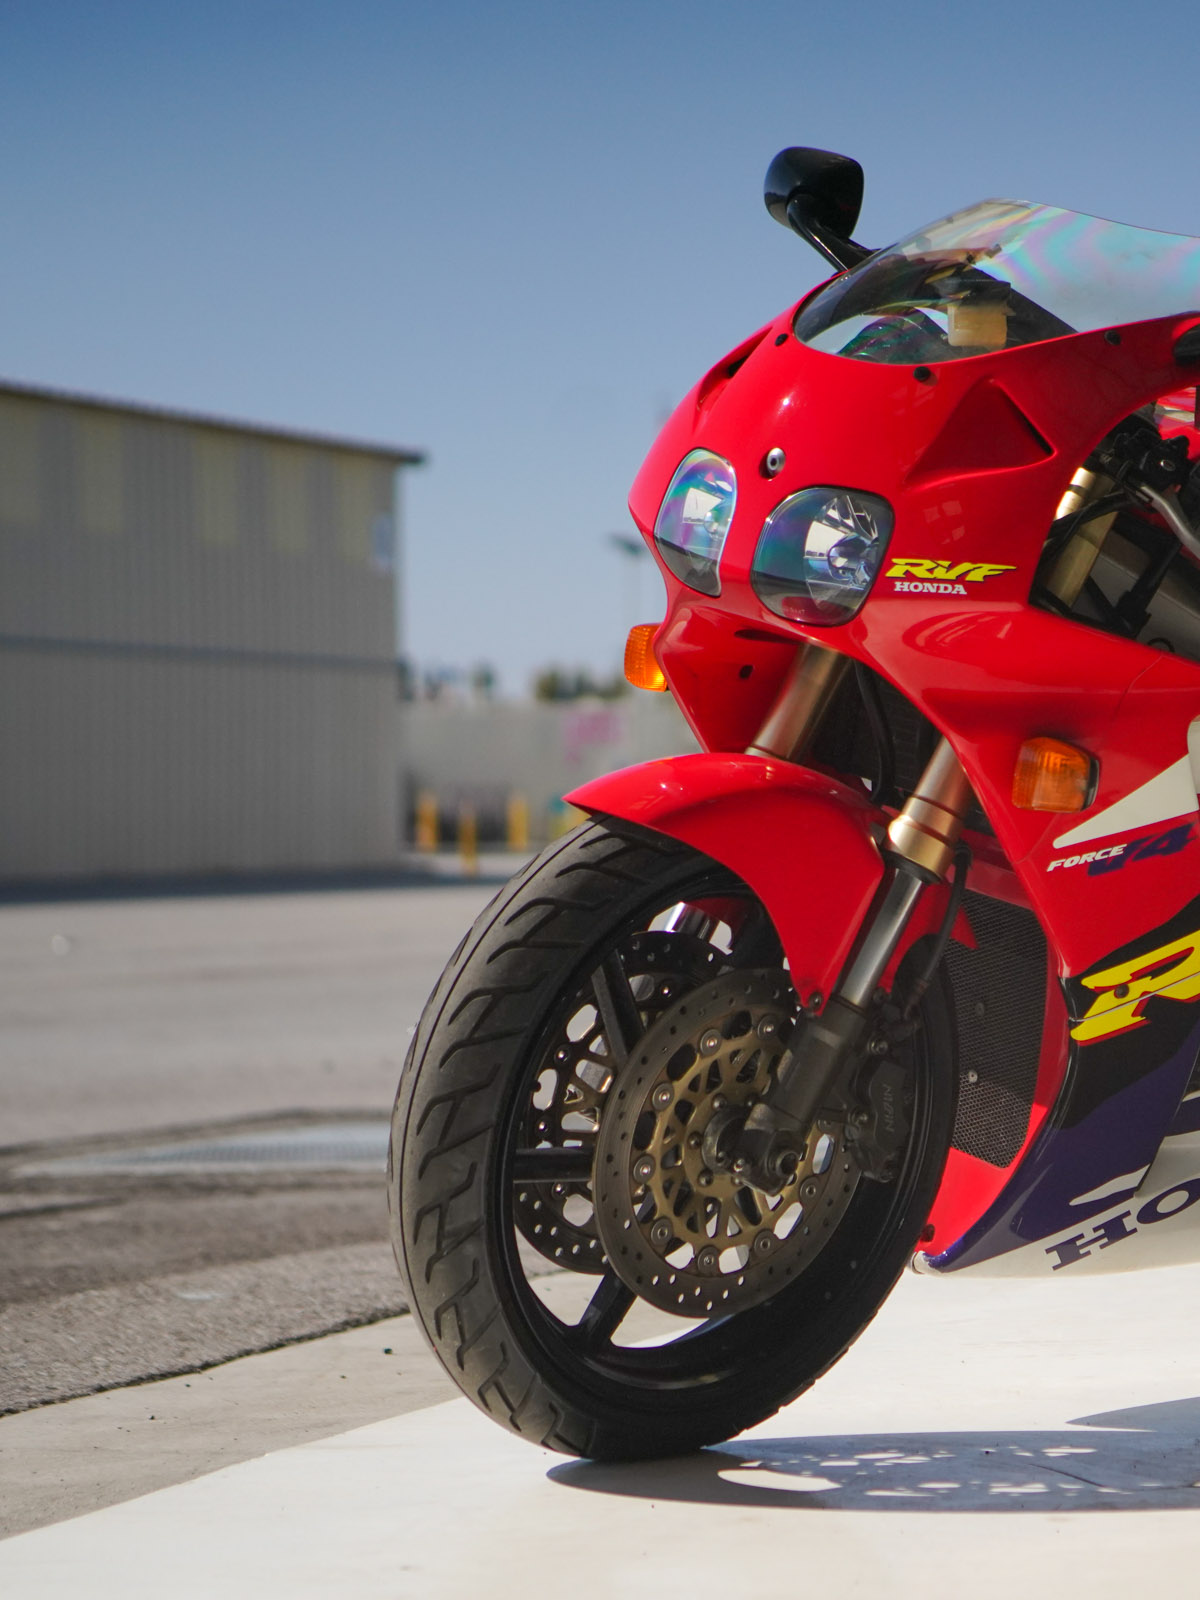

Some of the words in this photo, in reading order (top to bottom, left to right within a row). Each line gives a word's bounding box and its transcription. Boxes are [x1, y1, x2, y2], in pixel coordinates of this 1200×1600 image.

[885, 558, 1017, 582] RVF
[893, 581, 968, 595] HONDA
[1046, 843, 1128, 872] FORCE
[1087, 821, 1198, 877] V4
